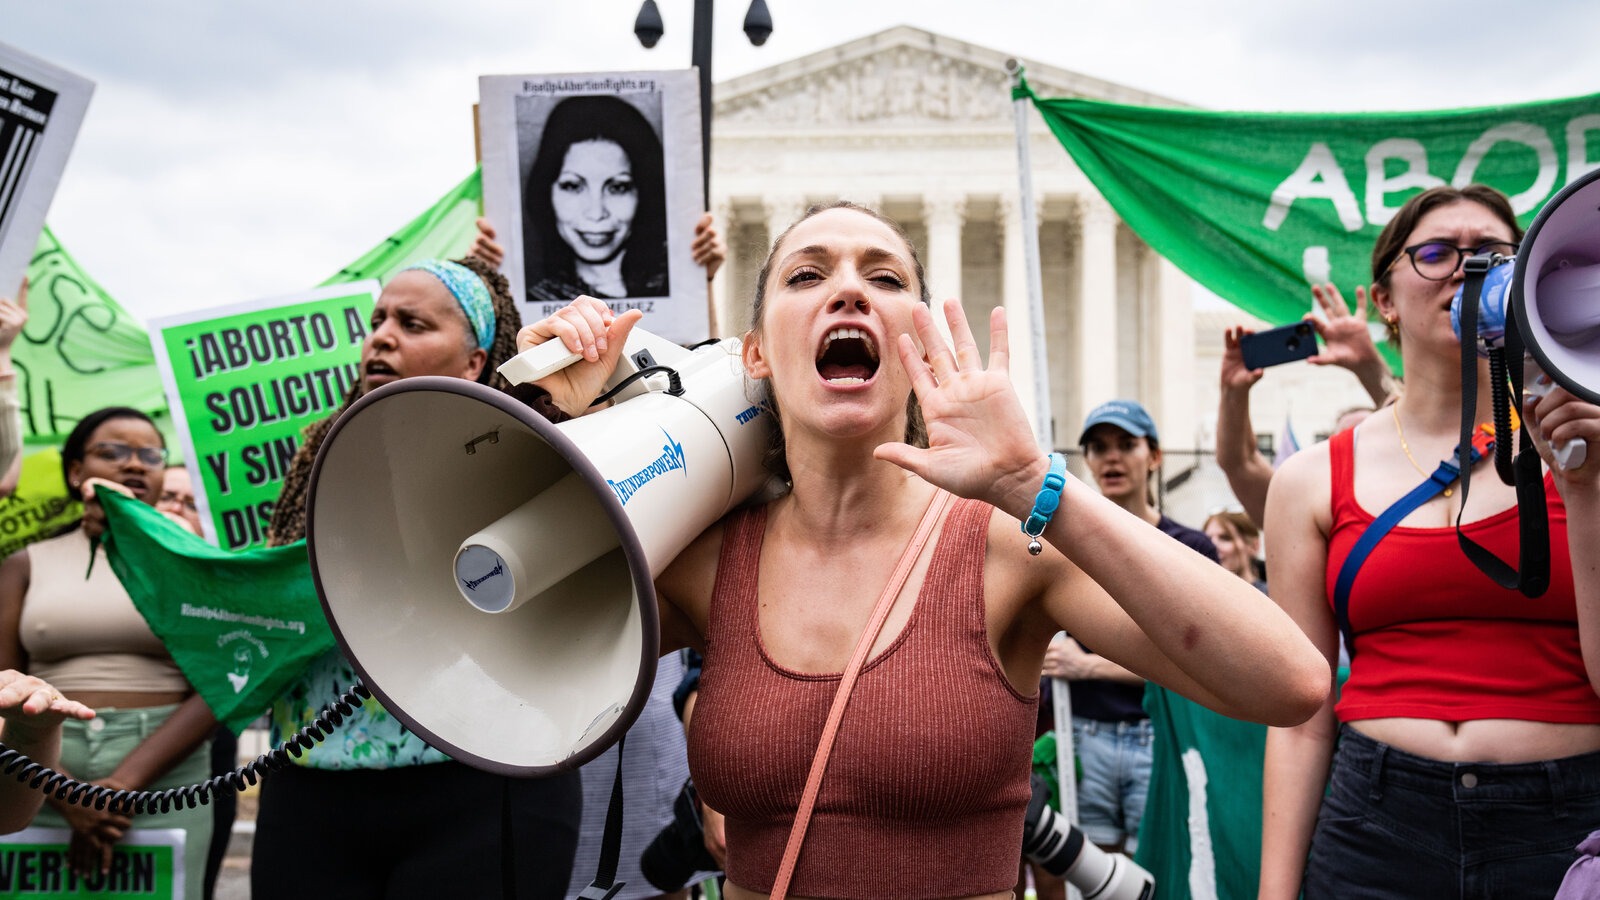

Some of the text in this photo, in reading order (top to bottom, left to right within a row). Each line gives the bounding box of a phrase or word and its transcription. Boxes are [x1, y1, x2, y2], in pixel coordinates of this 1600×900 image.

[542, 301, 655, 318] RO MENEZ
[186, 306, 367, 381] ¡ABORTO A
[205, 362, 361, 434] SOLICITU
[205, 435, 298, 495] Y SIN
